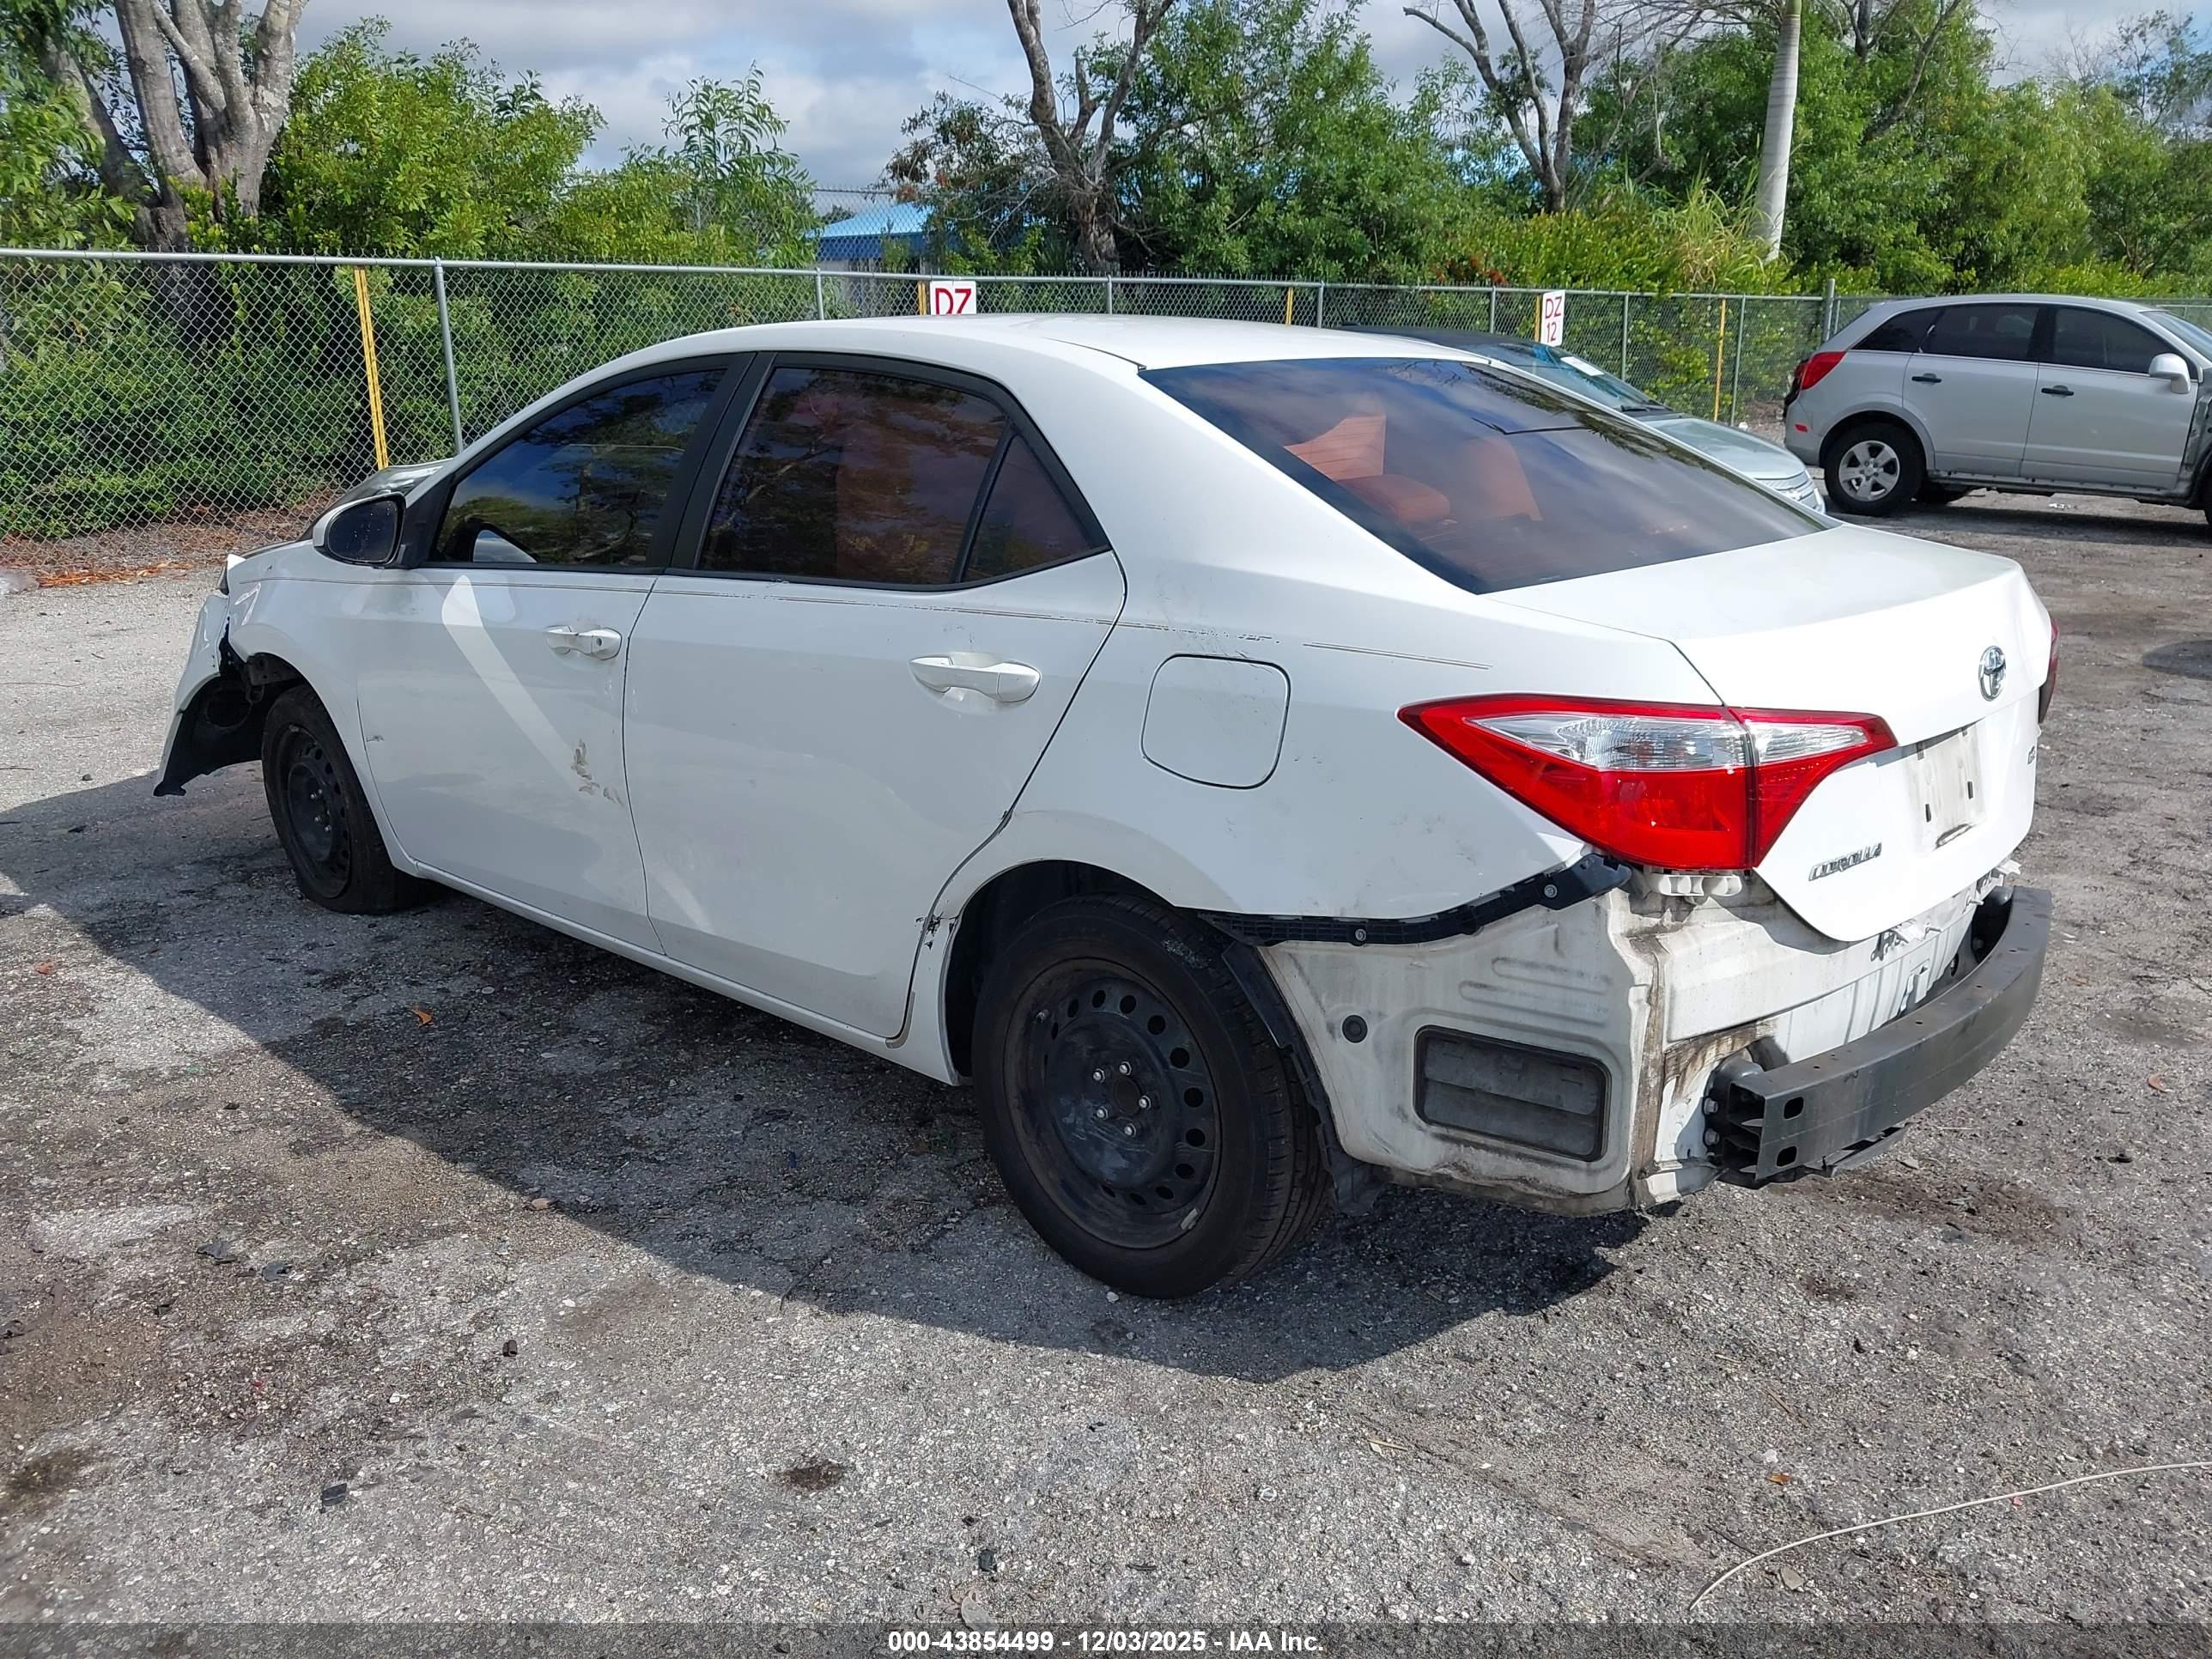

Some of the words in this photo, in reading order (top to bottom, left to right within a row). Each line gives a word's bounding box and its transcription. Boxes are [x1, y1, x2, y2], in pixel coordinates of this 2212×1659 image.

[1546, 296, 1562, 319] DZ
[1547, 322, 1557, 343] 12
[1808, 842, 1881, 881] COROLLA
